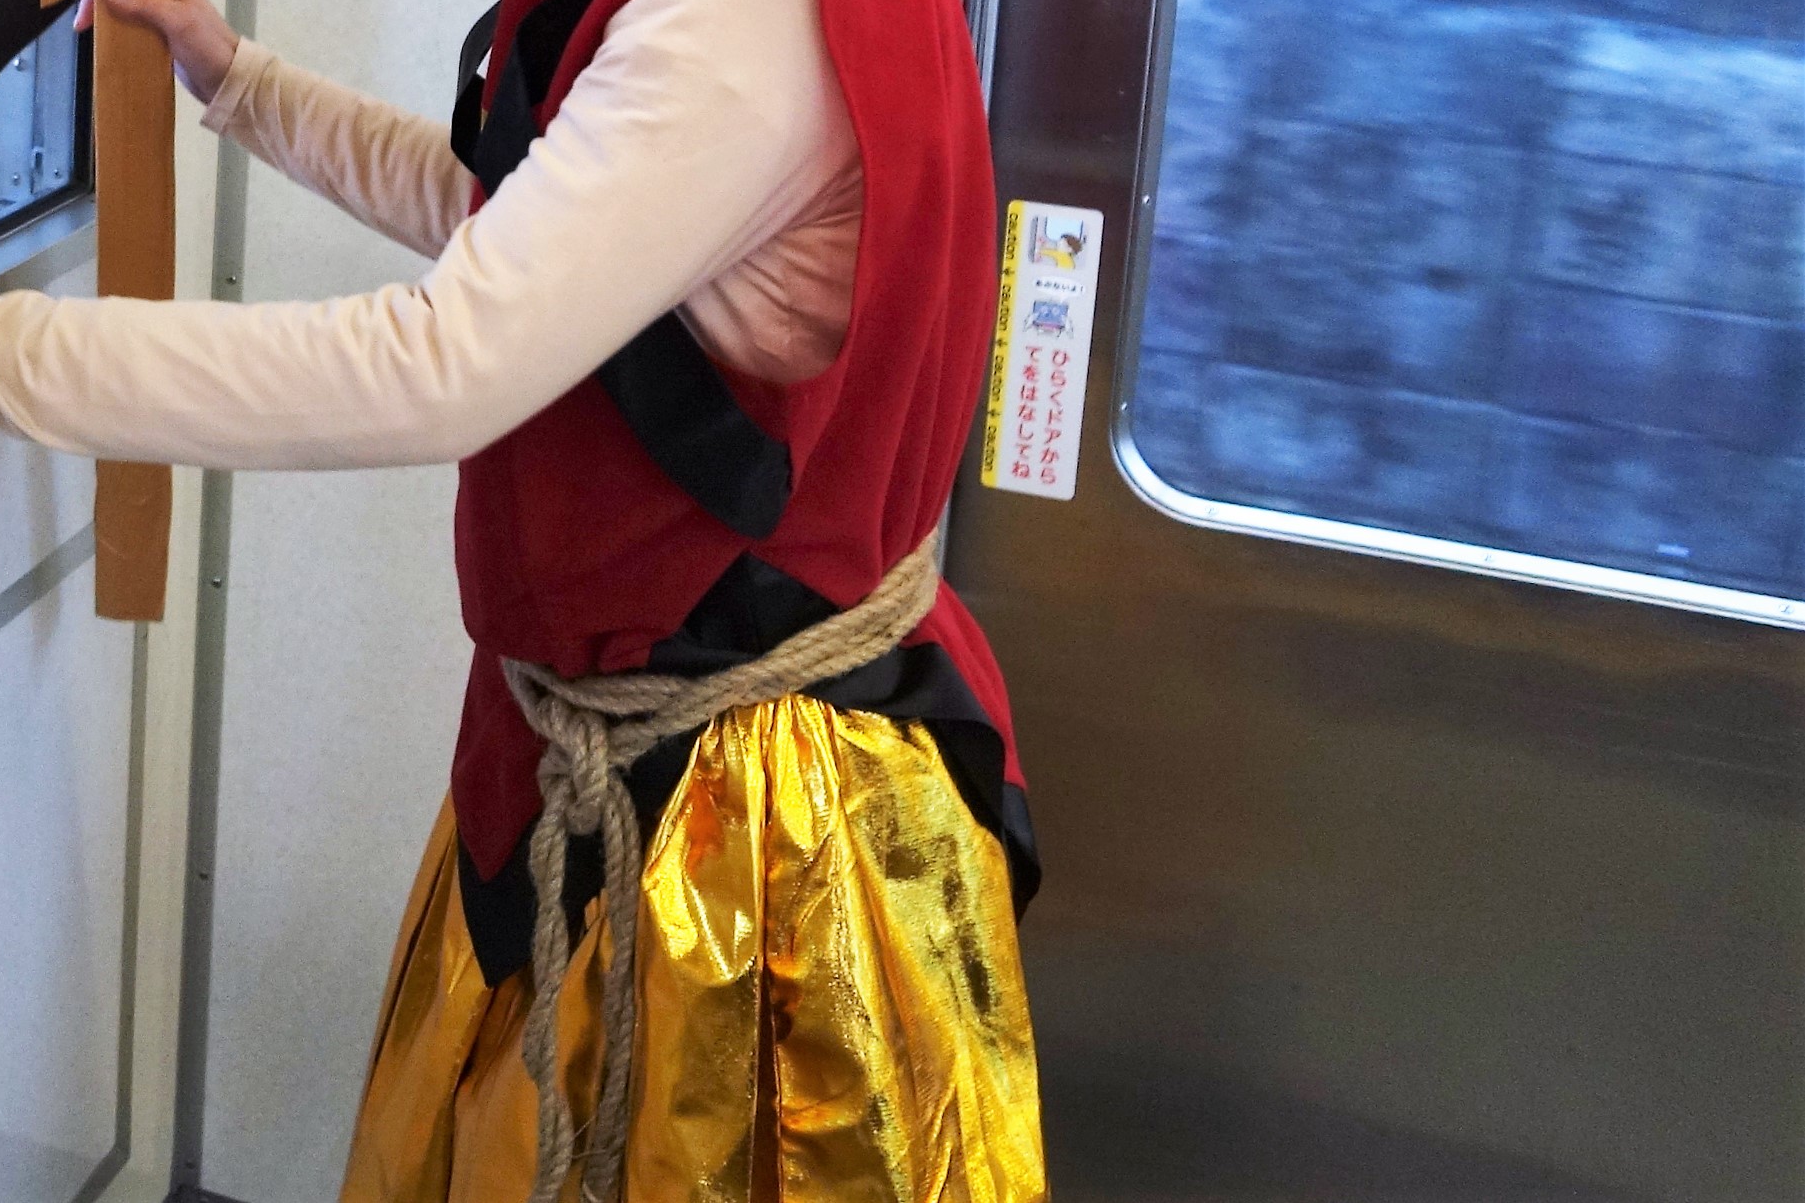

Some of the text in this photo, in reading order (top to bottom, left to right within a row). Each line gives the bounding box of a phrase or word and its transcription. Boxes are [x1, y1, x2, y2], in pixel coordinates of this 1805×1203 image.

[1011, 346, 1042, 481] てをはなしてね
[1040, 348, 1070, 486] ひらくドアから
